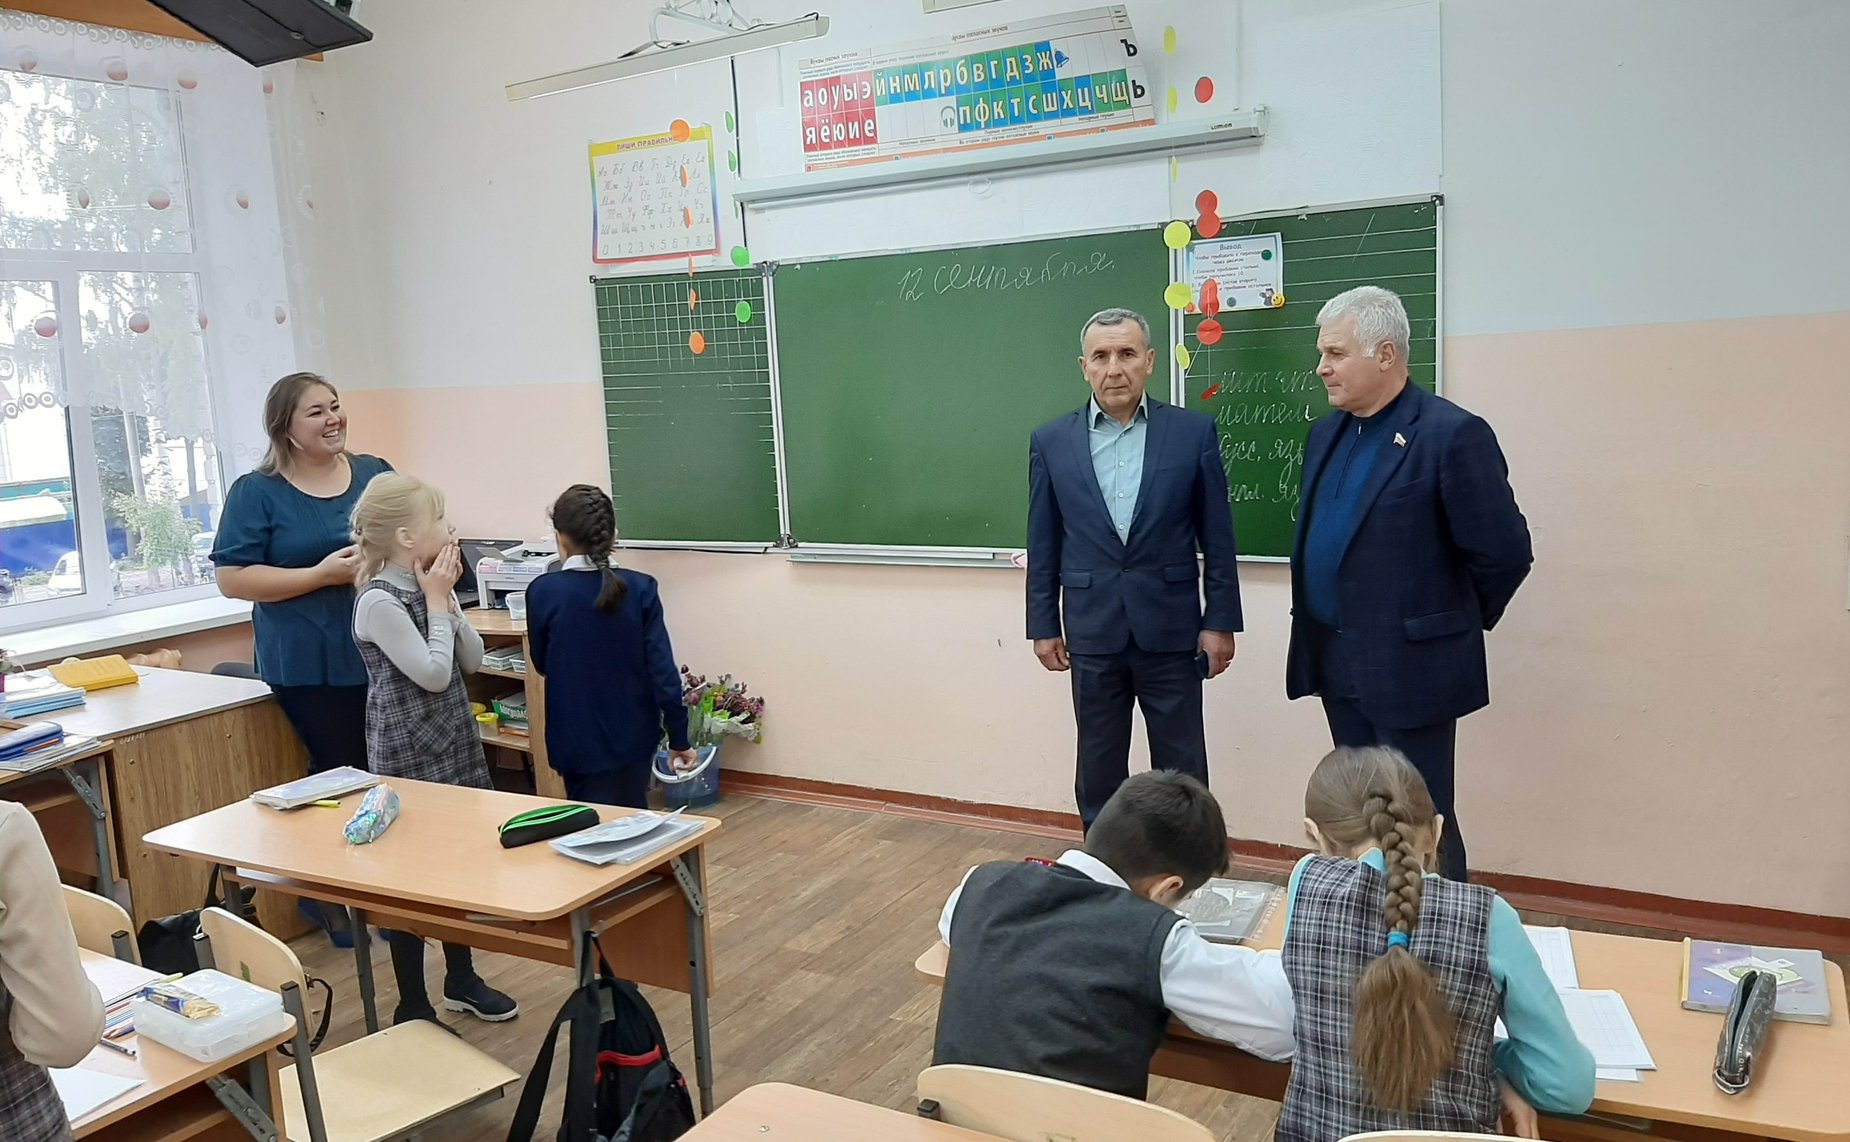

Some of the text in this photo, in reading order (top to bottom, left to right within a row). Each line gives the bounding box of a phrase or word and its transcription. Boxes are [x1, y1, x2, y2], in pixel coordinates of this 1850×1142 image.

[876, 51, 1053, 96] й н м л р б в г д з ж
[804, 81, 871, 110] а о у ы э
[959, 82, 1129, 128] п ф к т с ш х ц ч щ
[617, 142, 636, 150] ПИШИ
[806, 119, 874, 144] я ё ю и е
[602, 244, 609, 255] 0
[627, 243, 633, 253] 2
[640, 242, 644, 252] 3
[649, 241, 655, 251] 4
[660, 240, 666, 250] 5
[672, 239, 677, 249] 6
[684, 237, 690, 247] 7
[696, 235, 701, 246] 8
[898, 268, 924, 300] 12
